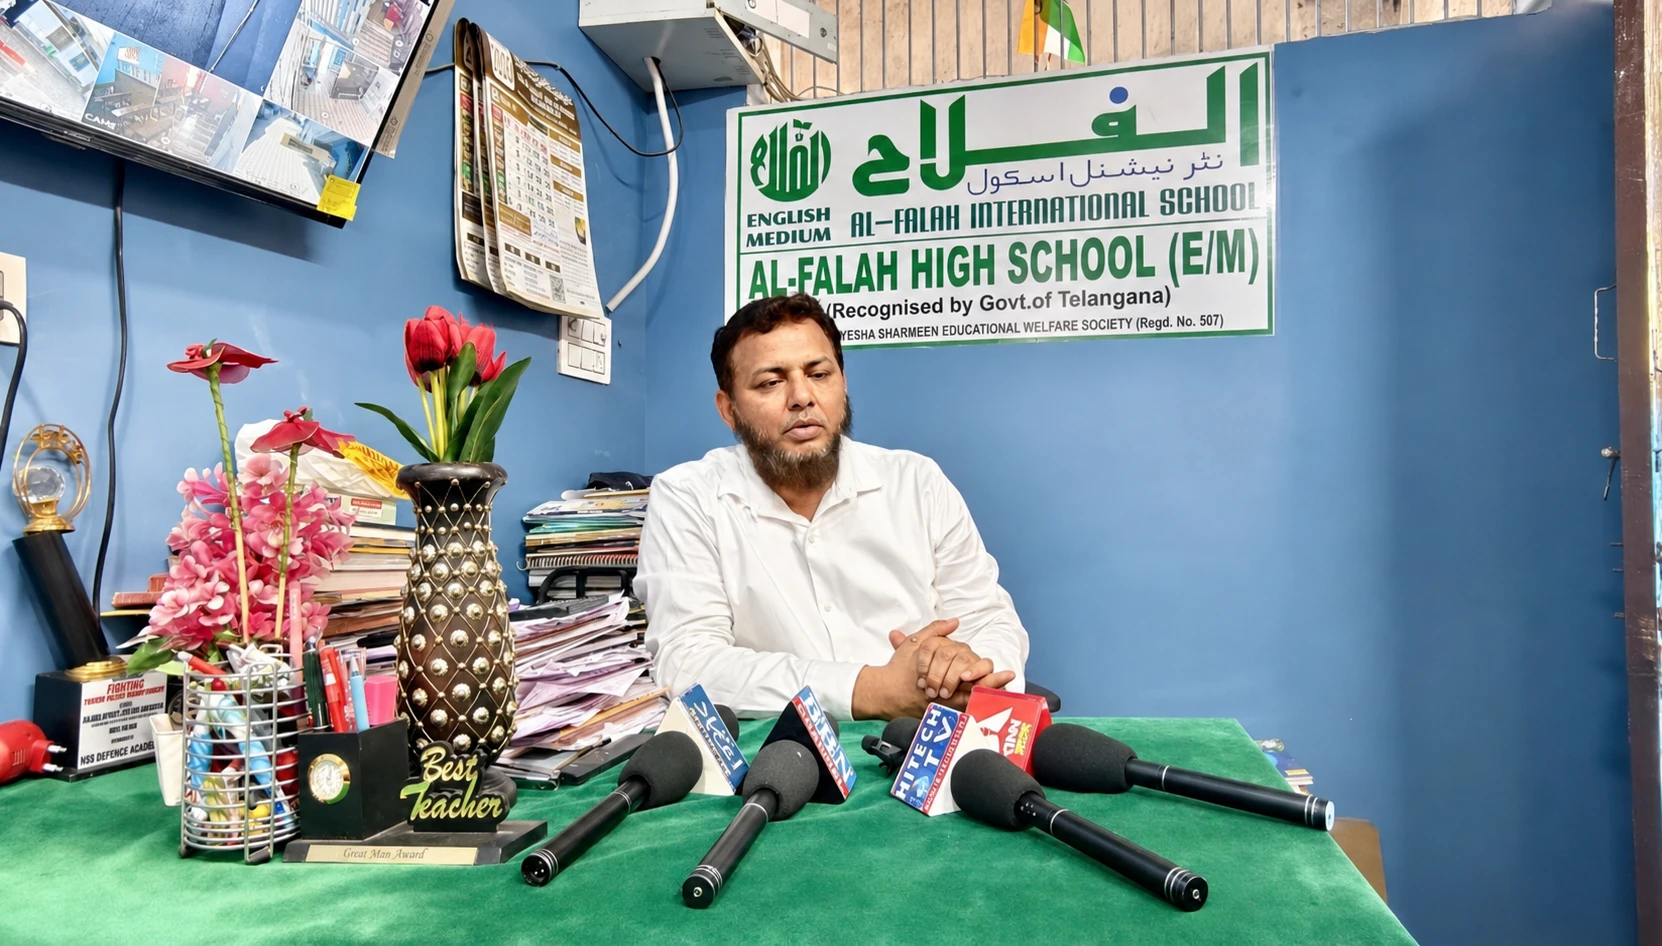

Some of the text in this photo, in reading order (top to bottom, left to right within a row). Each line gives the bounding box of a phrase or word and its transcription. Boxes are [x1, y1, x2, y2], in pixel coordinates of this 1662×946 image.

[852, 62, 1259, 197] الفلاح
[747, 207, 831, 227] ENGLISH
[851, 183, 1260, 238] AL-FALAH INTERNATIONAL SCHOOL
[746, 227, 831, 247] MEDIUM
[748, 227, 1260, 300] AL-FALAH HIGH SCHOOL (E/M)
[826, 285, 1171, 320] (Recognised by Govt.of Telangana)
[840, 313, 1224, 342] YESHA SHARMEEN EDUCATIONAL WELFARE SOCIETY (Regd. No. 507)
[107, 679, 145, 695] FIGHTING
[80, 740, 155, 766] NSS DEFENCE ACADE
[420, 746, 478, 782] Best
[895, 708, 942, 800] HITECH
[400, 774, 504, 820] Teacher
[343, 847, 428, 860] Great Man Award
